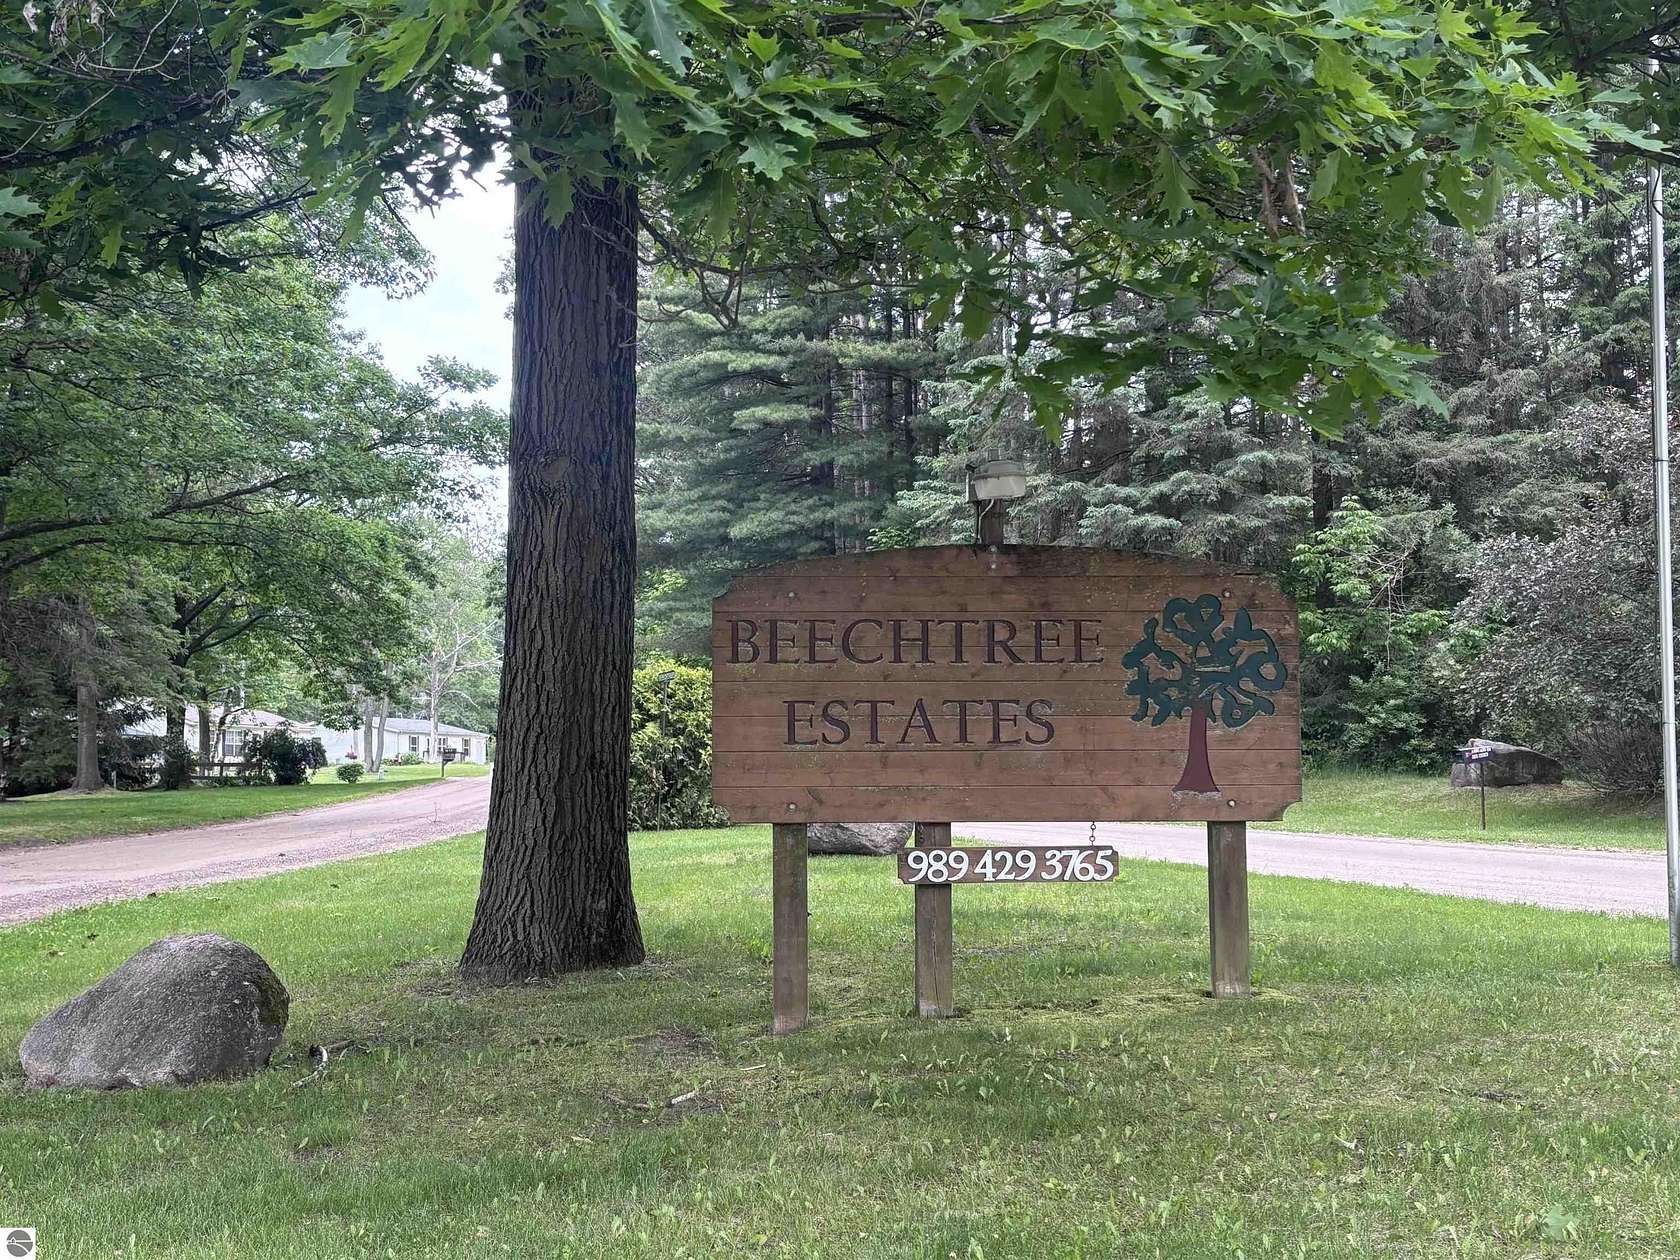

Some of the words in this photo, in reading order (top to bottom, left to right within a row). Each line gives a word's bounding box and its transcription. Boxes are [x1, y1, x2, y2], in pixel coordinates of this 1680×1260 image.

[727, 618, 1104, 665] BEECHTREE
[783, 698, 1056, 747] ESTATES
[907, 849, 969, 883] 989
[974, 849, 1037, 882] 429
[1041, 849, 1114, 881] 3765
